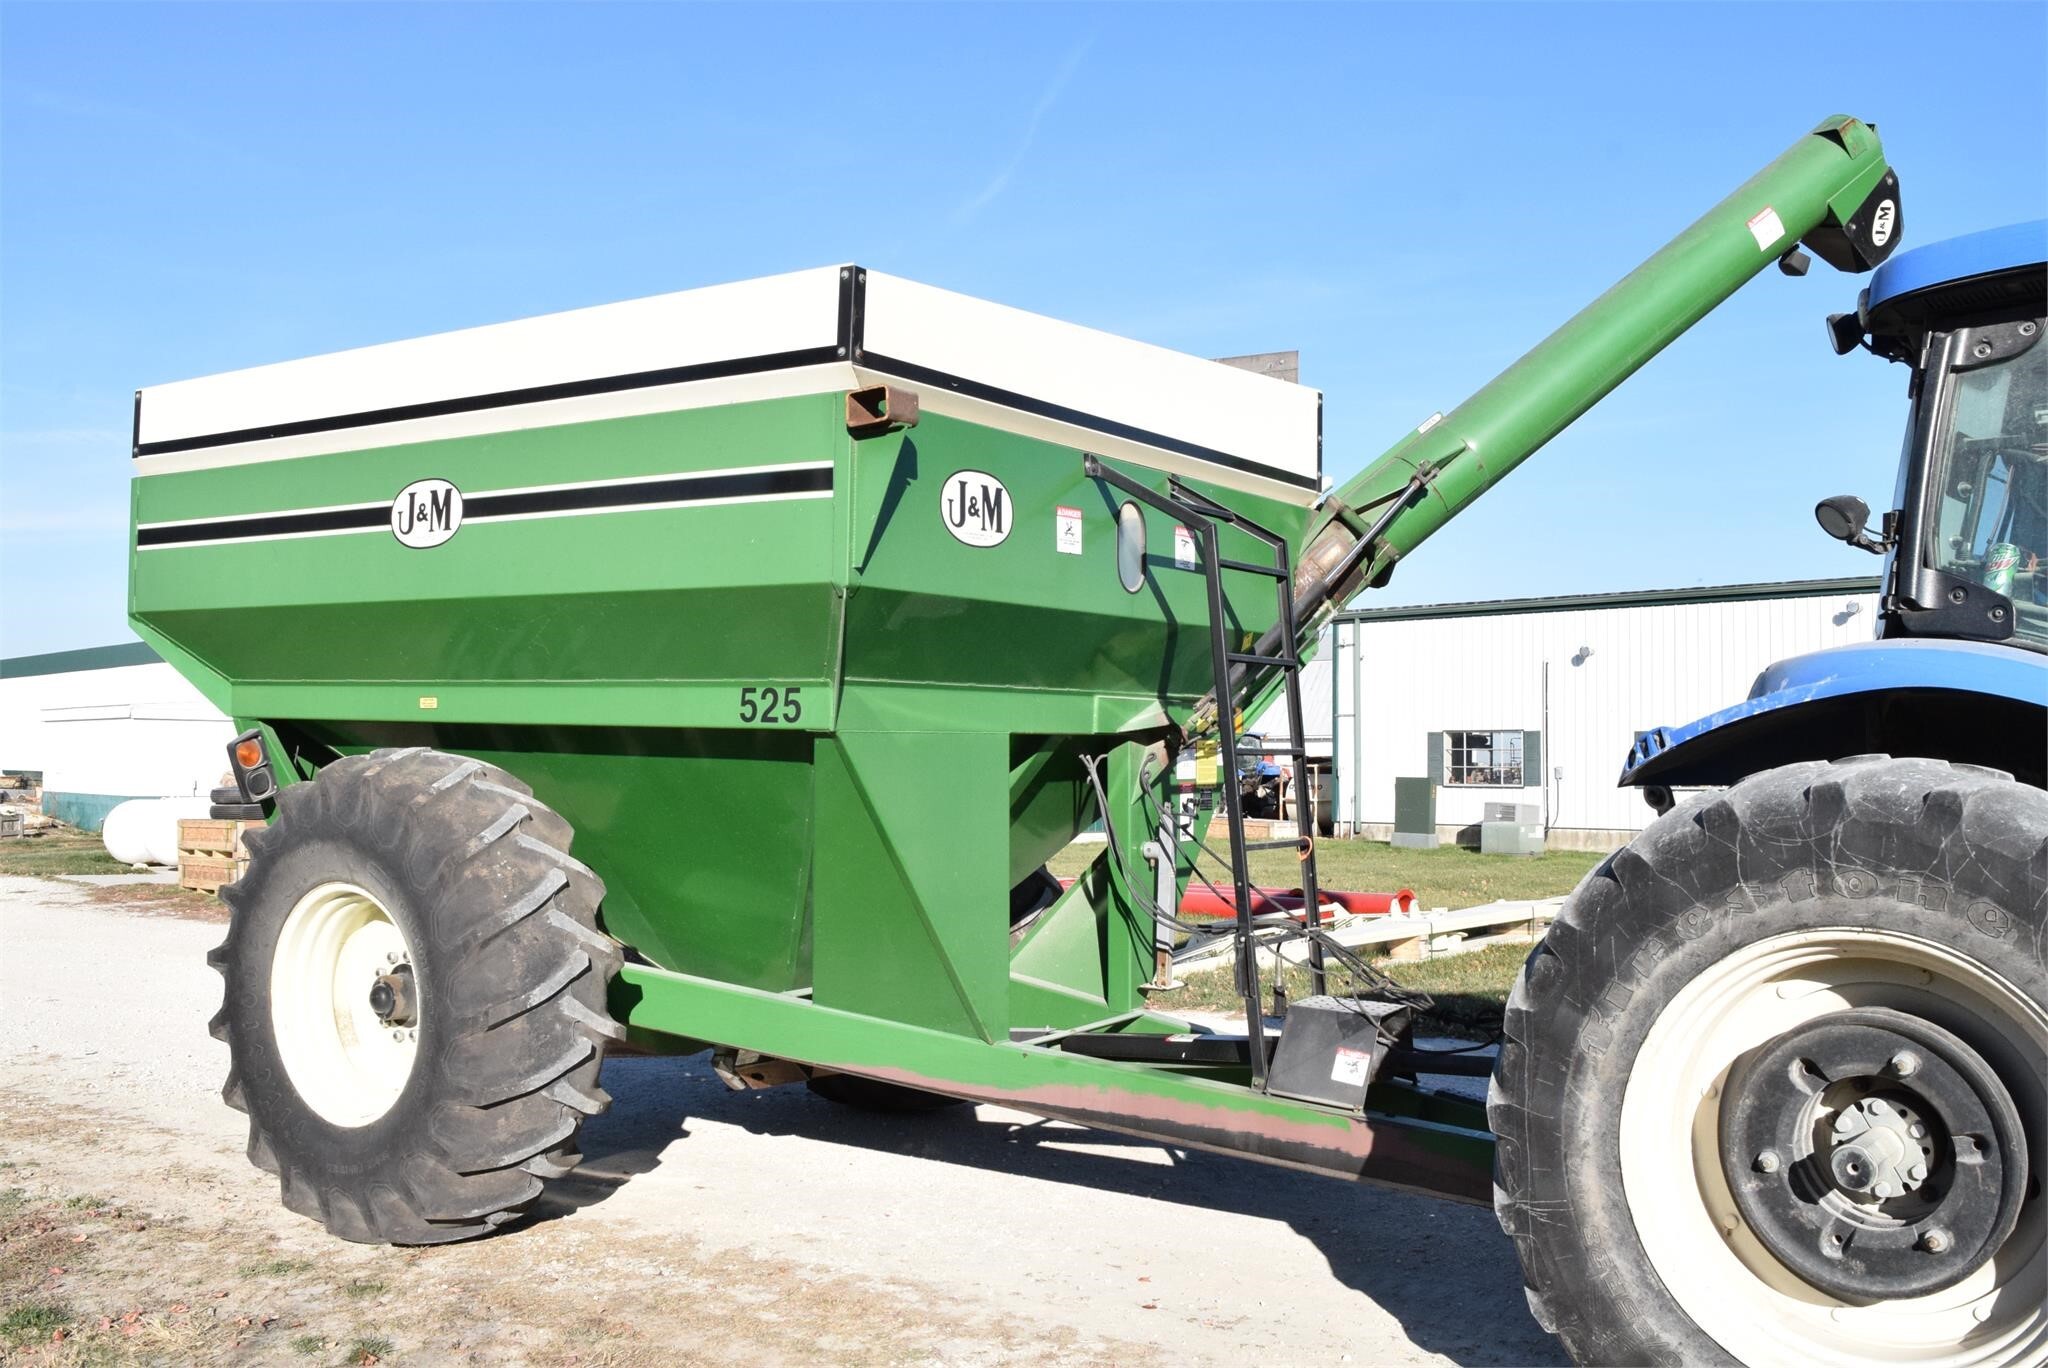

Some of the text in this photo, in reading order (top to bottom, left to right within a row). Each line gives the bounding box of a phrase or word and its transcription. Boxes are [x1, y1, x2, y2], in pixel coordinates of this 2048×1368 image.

[1875, 206, 1892, 242] J&M
[398, 487, 453, 535] J&M
[947, 480, 1004, 534] J&M
[739, 687, 802, 724] 525
